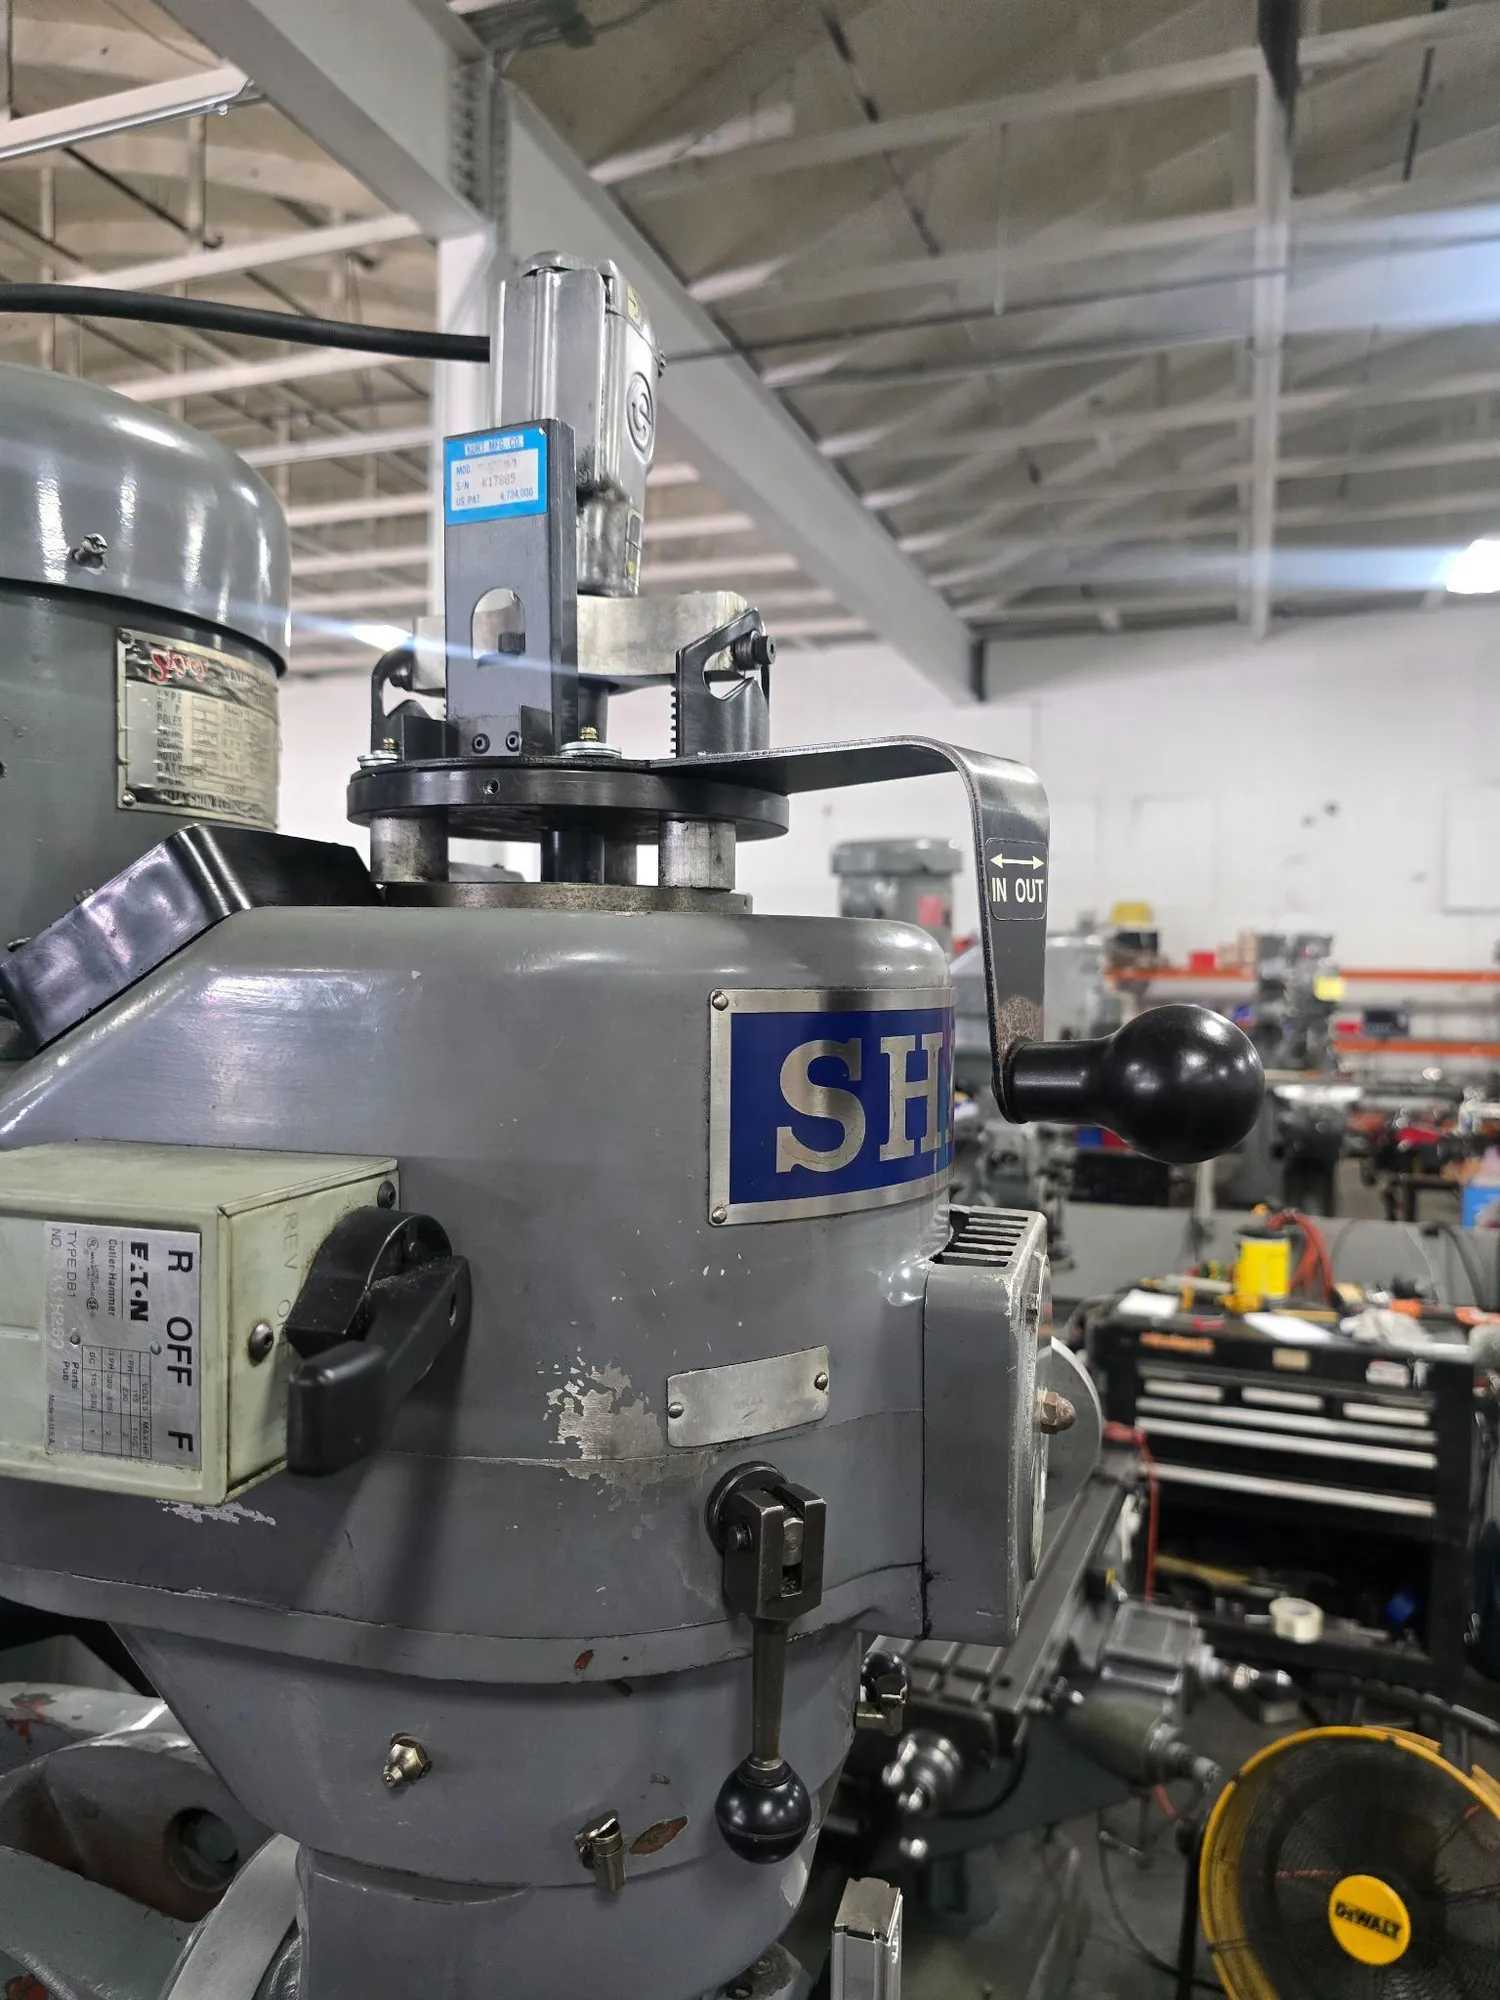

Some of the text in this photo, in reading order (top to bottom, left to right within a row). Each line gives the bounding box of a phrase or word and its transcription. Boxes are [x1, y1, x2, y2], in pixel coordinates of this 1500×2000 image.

[991, 877, 1044, 903] IN OUT
[776, 1032, 953, 1173] SH
[66, 1230, 77, 1297] TYPE DB1
[130, 1241, 149, 1322] EATON
[167, 1249, 194, 1453] R OFF F
